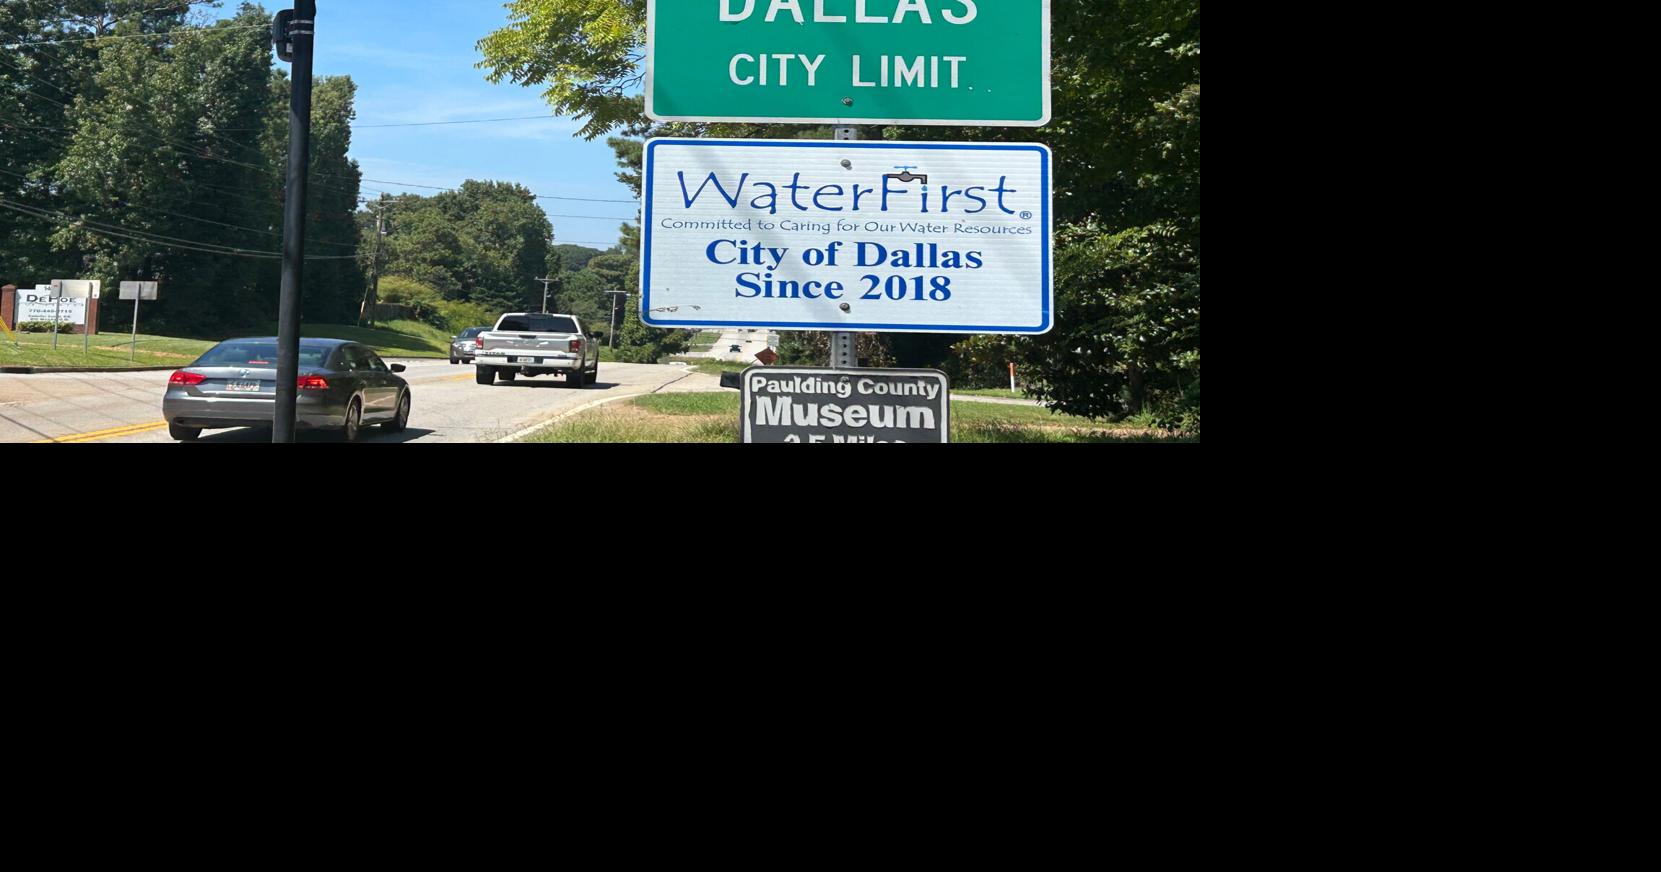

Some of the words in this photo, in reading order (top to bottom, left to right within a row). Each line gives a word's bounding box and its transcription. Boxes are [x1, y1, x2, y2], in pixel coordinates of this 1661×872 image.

[729, 53, 825, 86] CITY
[853, 54, 966, 88] LIMIT
[660, 217, 752, 231] Committed
[757, 219, 776, 231] to
[780, 219, 832, 235] Caring
[836, 219, 861, 233] for
[865, 220, 897, 233] Our
[899, 221, 949, 234] Water
[954, 222, 1033, 236] Resources
[705, 239, 789, 270] City
[802, 241, 844, 267] of
[853, 242, 983, 270] Dallas
[735, 272, 844, 300] Since
[859, 275, 952, 302] 2018
[751, 376, 852, 398] Paulding
[857, 378, 940, 399] County
[755, 395, 936, 429] Museum
